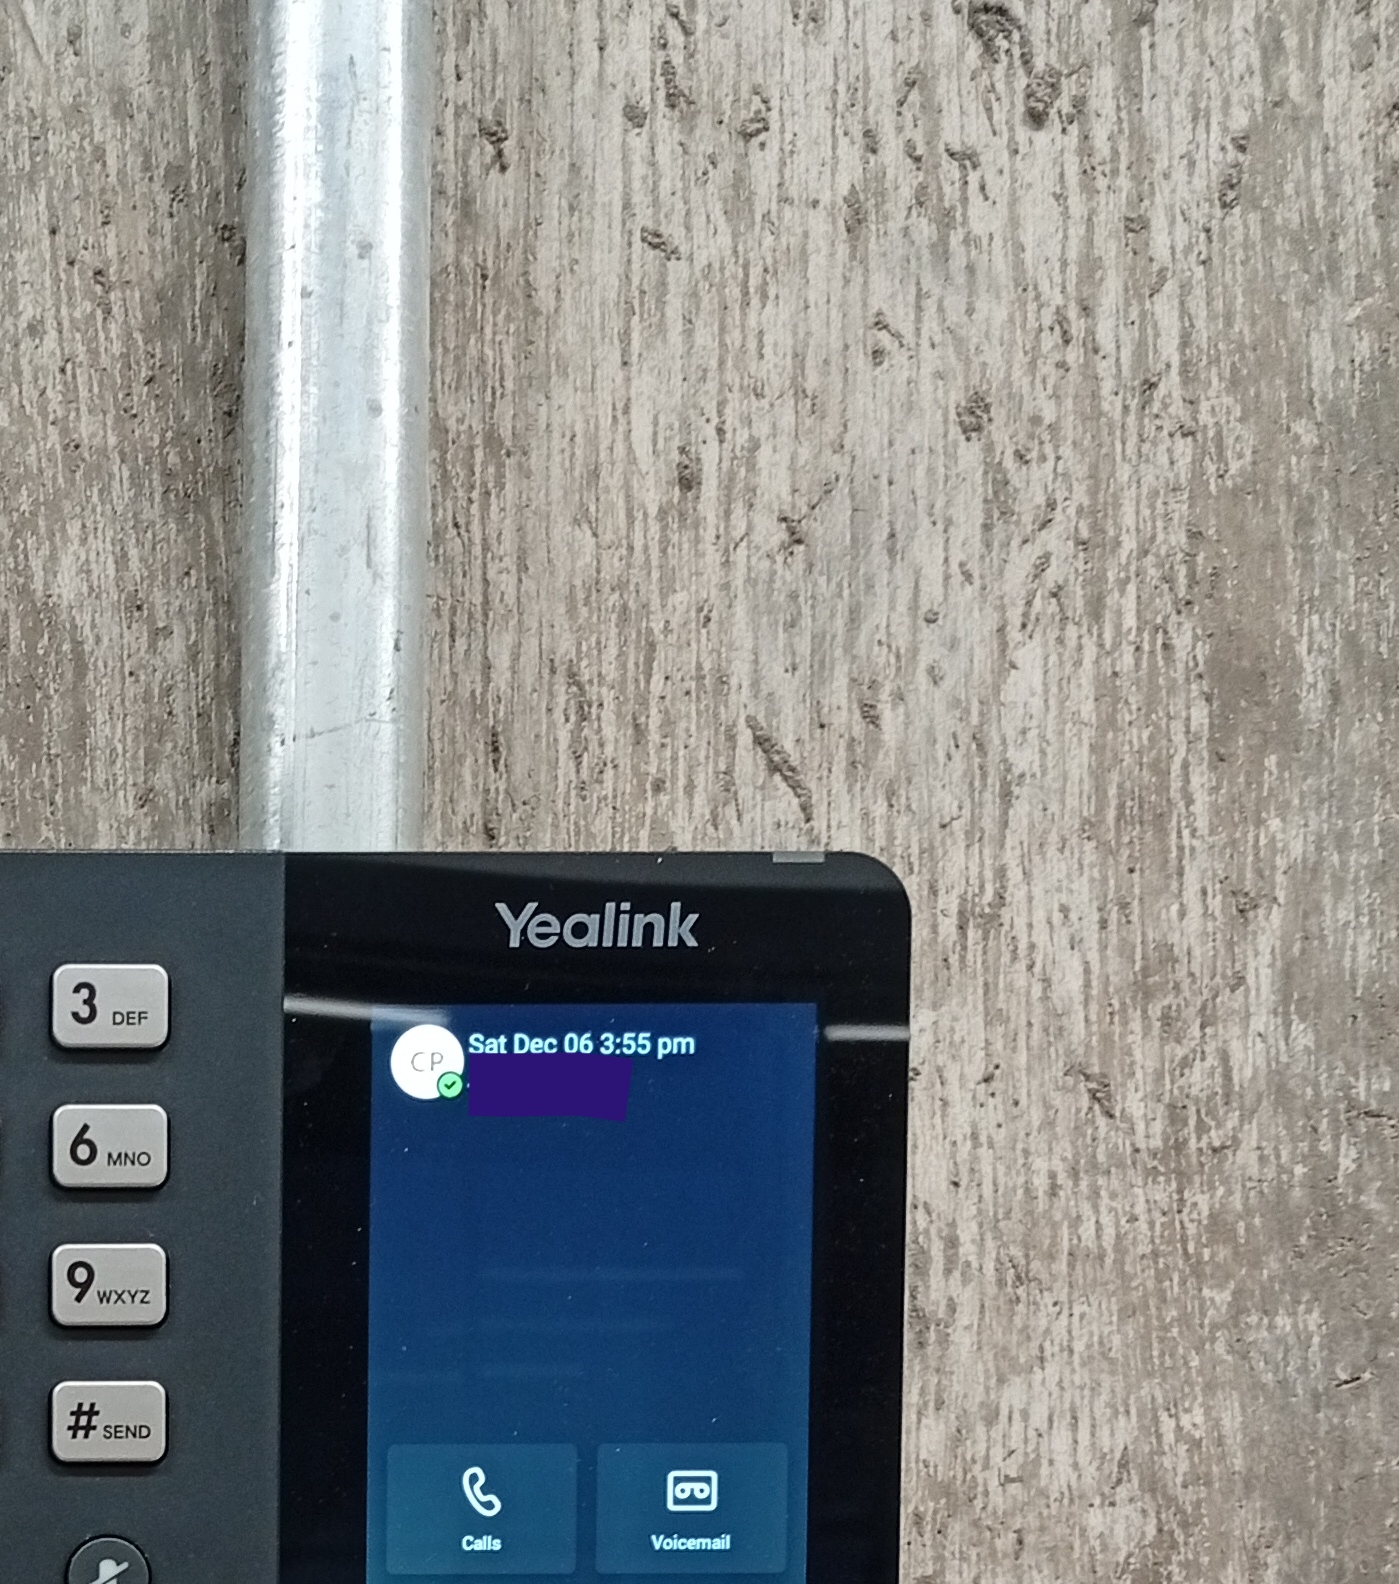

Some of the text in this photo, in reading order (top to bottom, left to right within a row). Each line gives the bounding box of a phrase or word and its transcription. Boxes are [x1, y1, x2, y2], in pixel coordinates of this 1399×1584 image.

[495, 901, 700, 948] Yealink
[71, 982, 148, 1026] 3 DEF
[469, 1032, 695, 1060] Sat Dec 06 3:55 pm
[411, 1052, 444, 1072] CP
[69, 1124, 151, 1167] 6 MNO
[67, 1261, 150, 1304] 9 WXYZ
[103, 1424, 151, 1440] SEND
[461, 1535, 502, 1551] Calls
[651, 1534, 731, 1551] Voicemail
